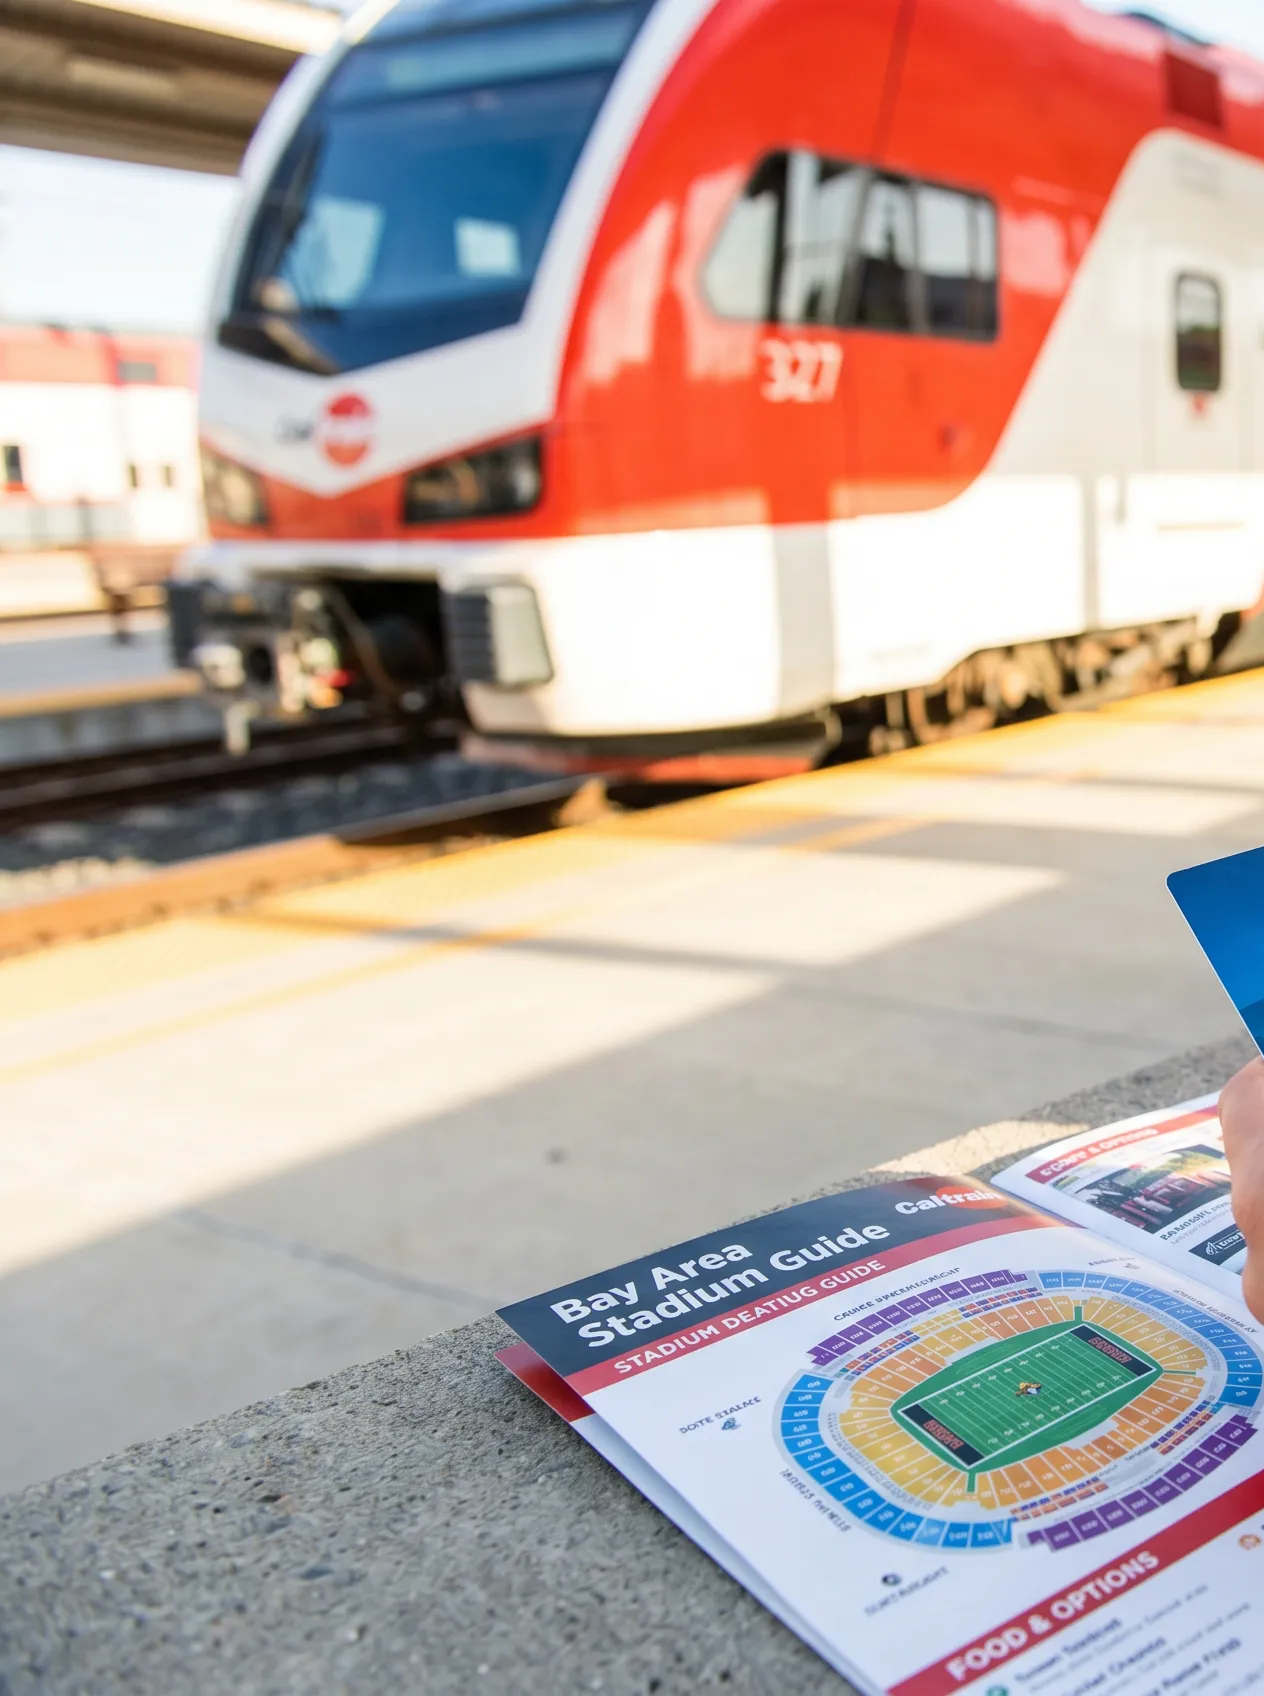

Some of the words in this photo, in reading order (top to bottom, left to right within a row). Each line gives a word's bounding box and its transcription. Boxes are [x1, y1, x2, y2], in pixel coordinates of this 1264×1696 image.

[759, 339, 844, 403] 327
[894, 1187, 1000, 1215] Caltrain
[549, 1278, 641, 1325] Bay
[651, 1242, 753, 1292] Area
[577, 1267, 768, 1349] Stadium
[769, 1221, 890, 1272] Guide
[613, 1325, 720, 1374] STADIUM
[820, 1259, 886, 1290] GUIDE
[945, 1630, 1029, 1682] FOOD
[1030, 1613, 1052, 1636] &
[1050, 1550, 1160, 1621] OPTIONS
